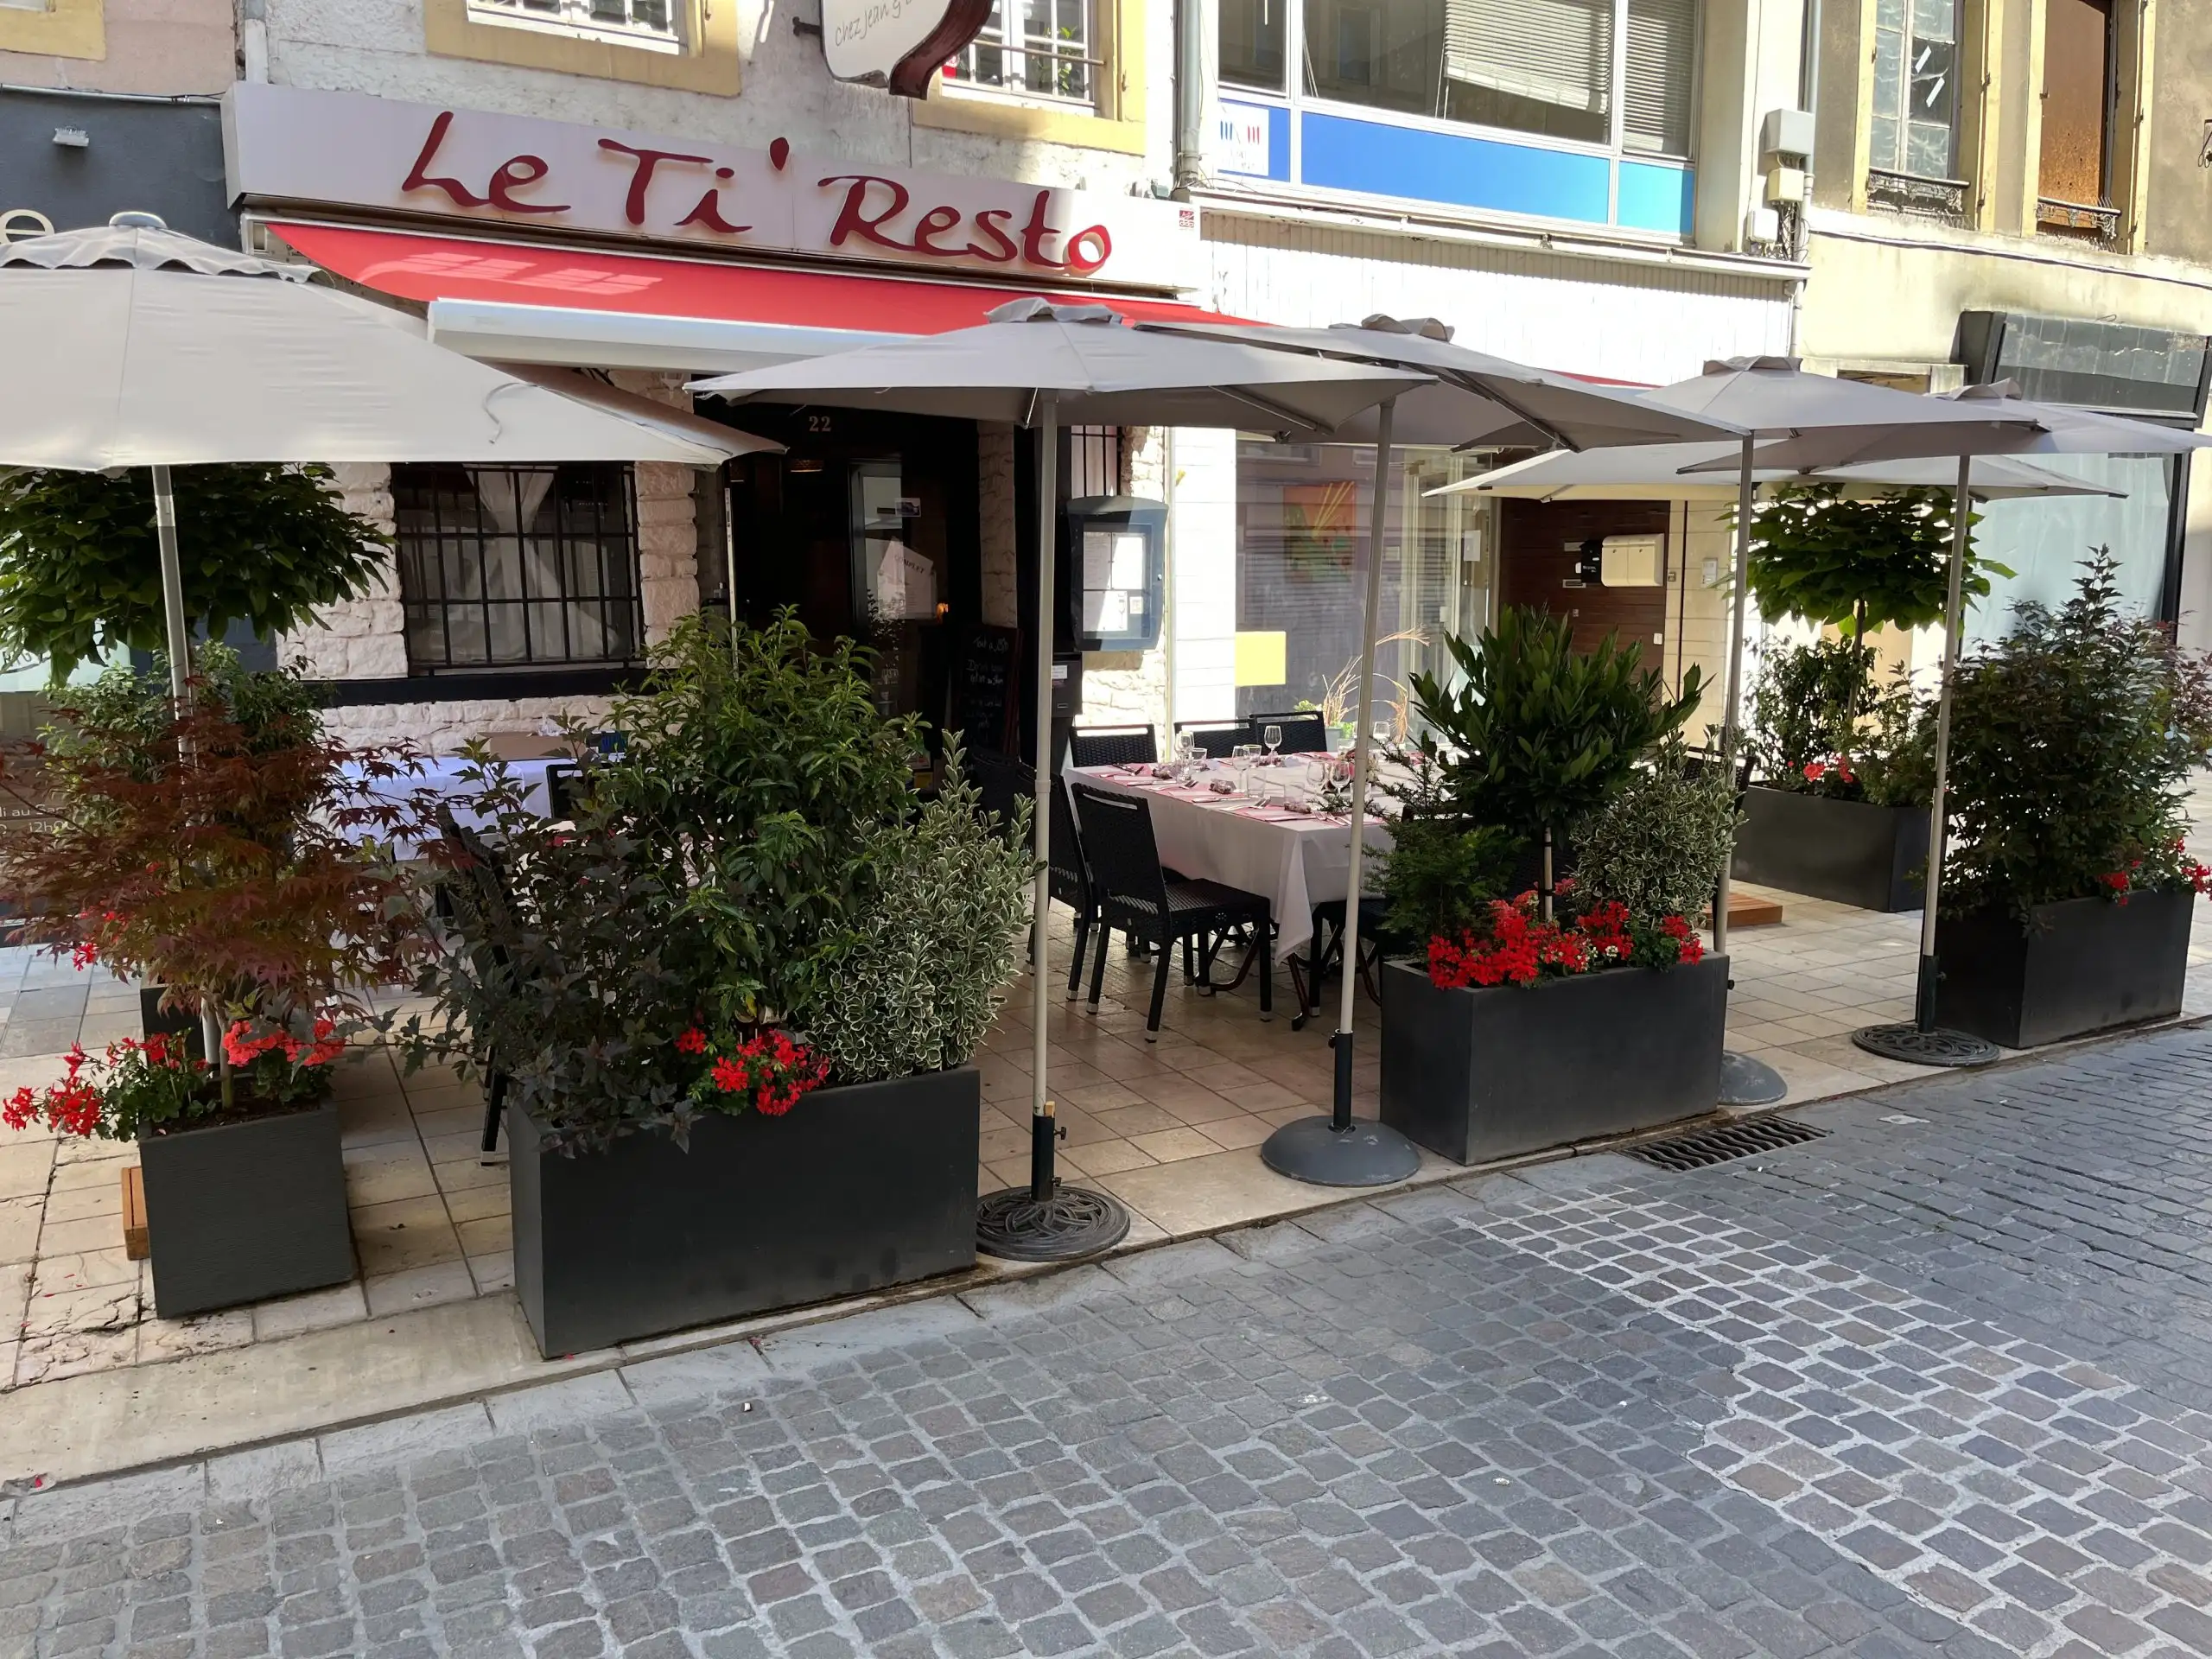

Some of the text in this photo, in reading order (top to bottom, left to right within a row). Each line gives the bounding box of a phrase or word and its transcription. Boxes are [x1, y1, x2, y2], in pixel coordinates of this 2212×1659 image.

[402, 111, 571, 214] Le
[817, 175, 1112, 270] Resto
[808, 416, 831, 432] 22
[12, 808, 29, 817] au
